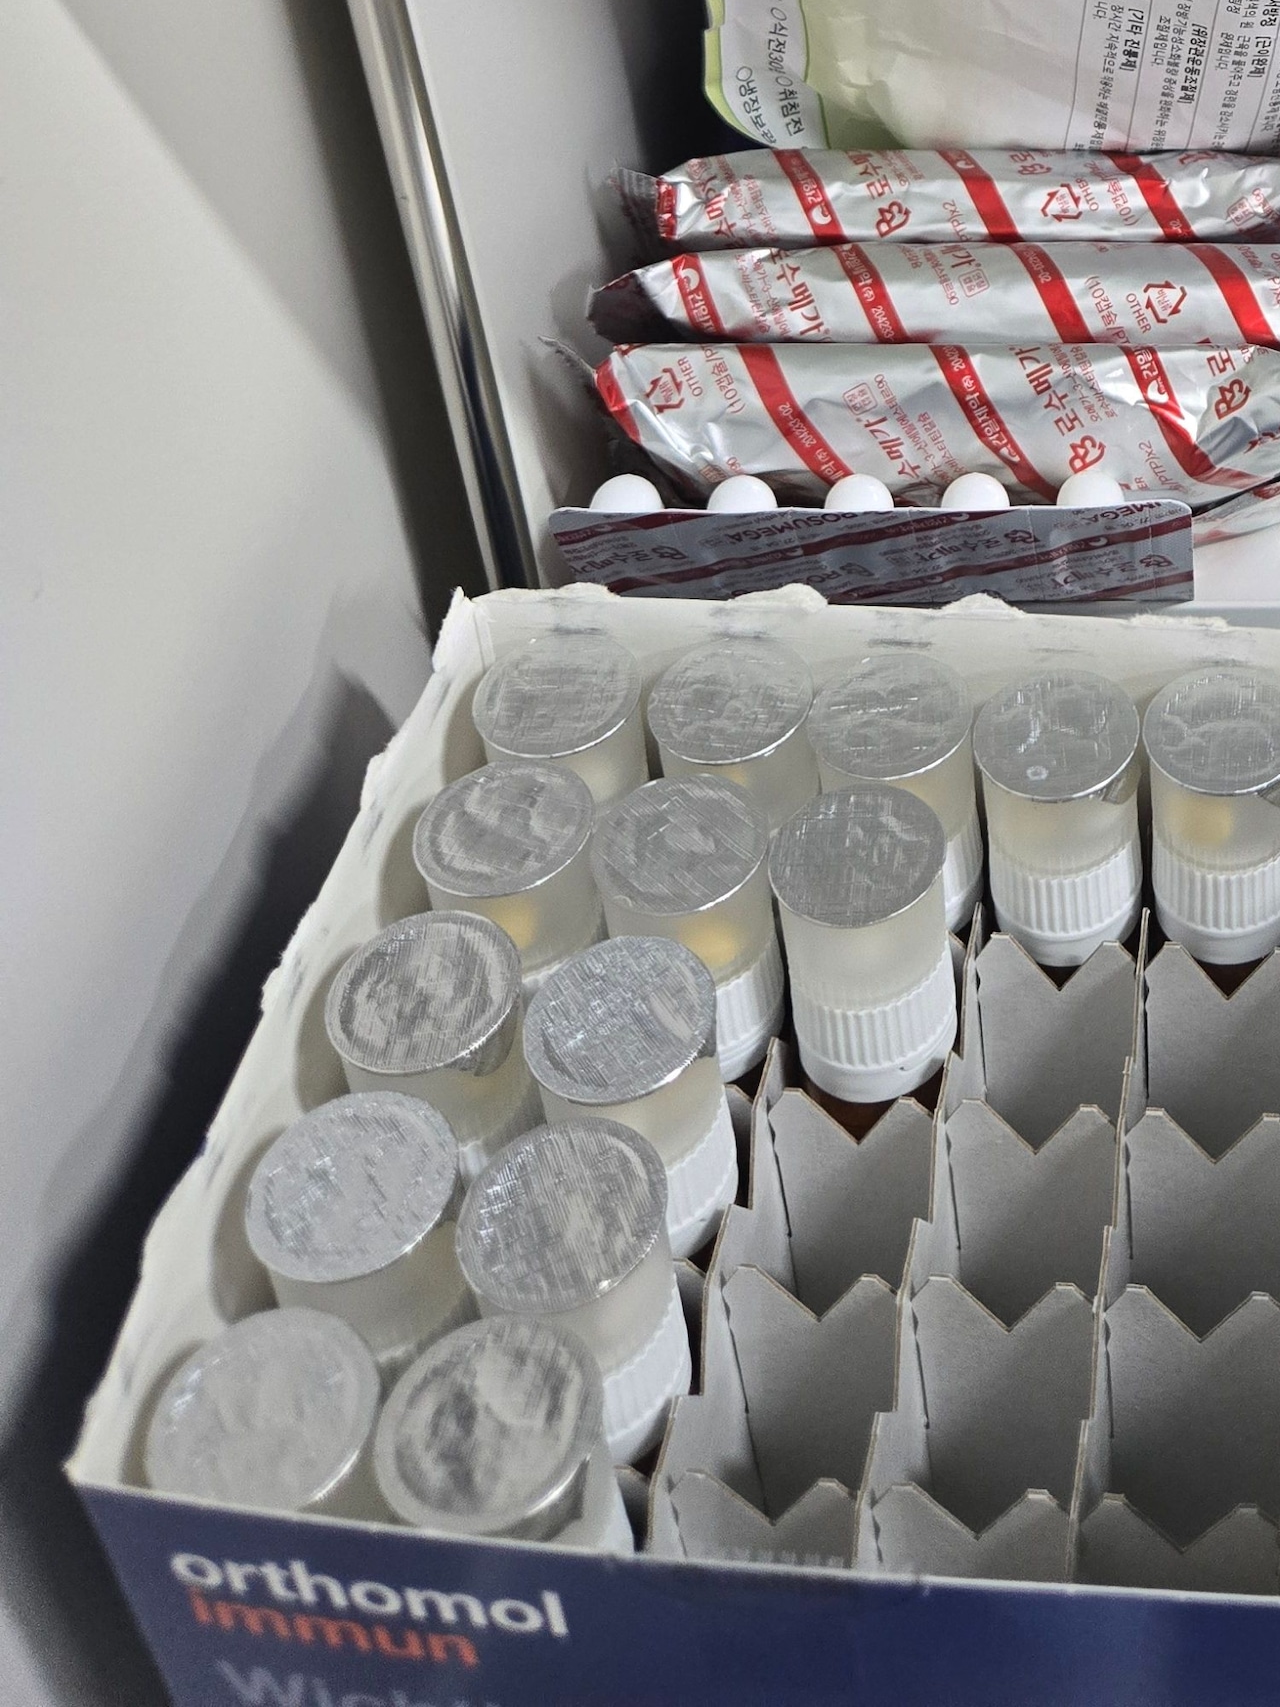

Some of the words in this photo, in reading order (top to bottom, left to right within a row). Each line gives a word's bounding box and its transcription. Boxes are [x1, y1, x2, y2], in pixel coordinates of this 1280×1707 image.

[1108, 5, 1124, 32] 장시간
[1102, 33, 1119, 74] 지속적으로
[1119, 39, 1141, 71] 진통제]
[1151, 15, 1171, 67] 조절제입니다.
[1215, 32, 1236, 71] 완제입니다.
[1247, 36, 1272, 78] [근이완제]
[1177, 23, 1208, 104] [위장관운동조절제]
[777, 87, 805, 137] 취침전
[1076, 177, 1100, 214] OTHER
[1126, 292, 1152, 334] OTHER
[677, 356, 703, 397] OTHER
[1016, 345, 1083, 437] 로수메가
[170, 1552, 569, 1638] orthomol
[189, 1585, 480, 1669] immun
